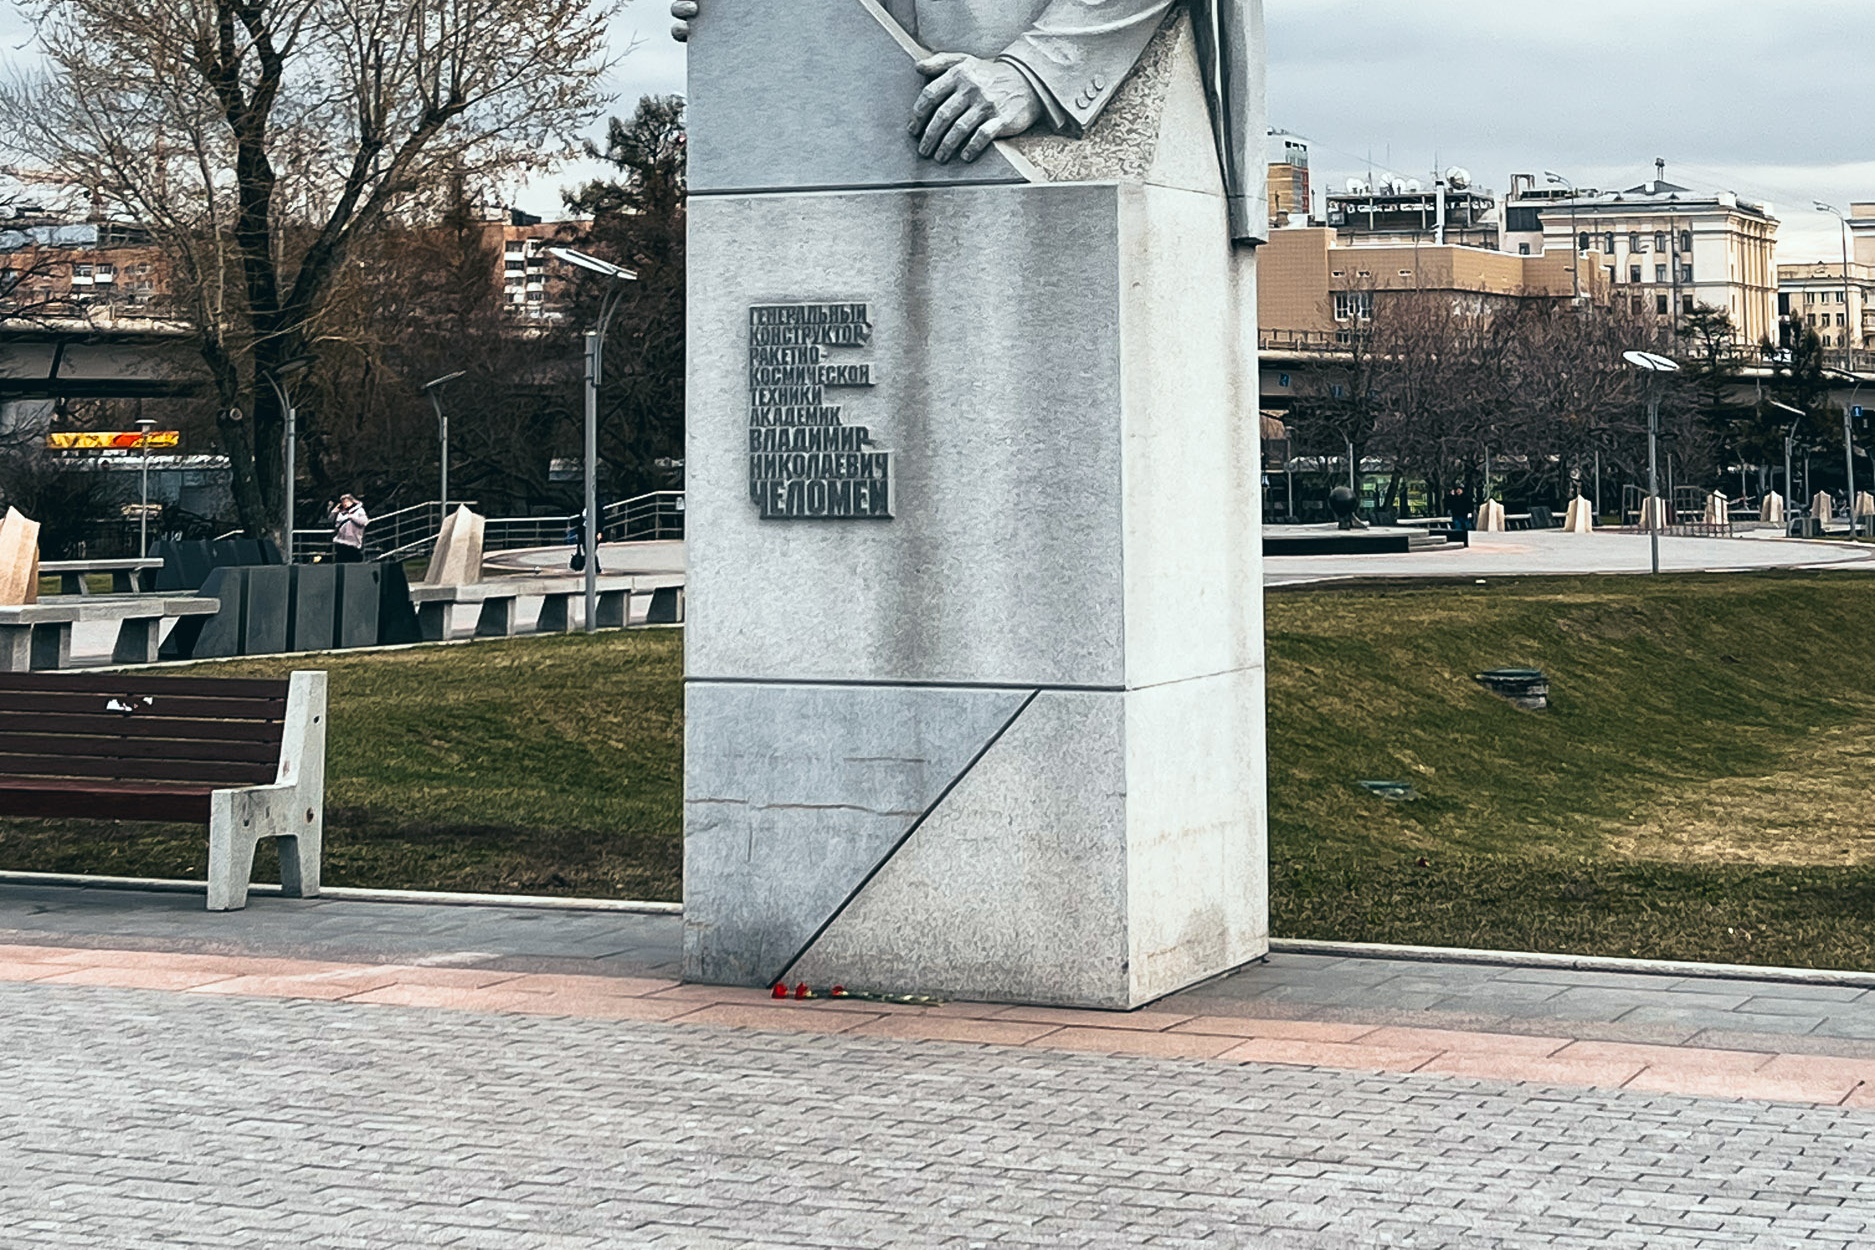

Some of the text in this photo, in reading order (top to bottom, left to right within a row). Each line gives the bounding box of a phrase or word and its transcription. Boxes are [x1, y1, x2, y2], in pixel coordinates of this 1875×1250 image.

[749, 304, 867, 325] ГЕНЕРАЛЬНЫЙ
[749, 324, 869, 345] КОНСТРУКТОР
[749, 364, 870, 385] КОСМИЧЕСКОЙ
[749, 385, 822, 406] ТЕХНИКИ
[749, 406, 842, 426] АКАДЕМИК
[749, 427, 870, 452] ВЛАДИМИР
[749, 452, 889, 479] НИКОЛАЕВИЧ
